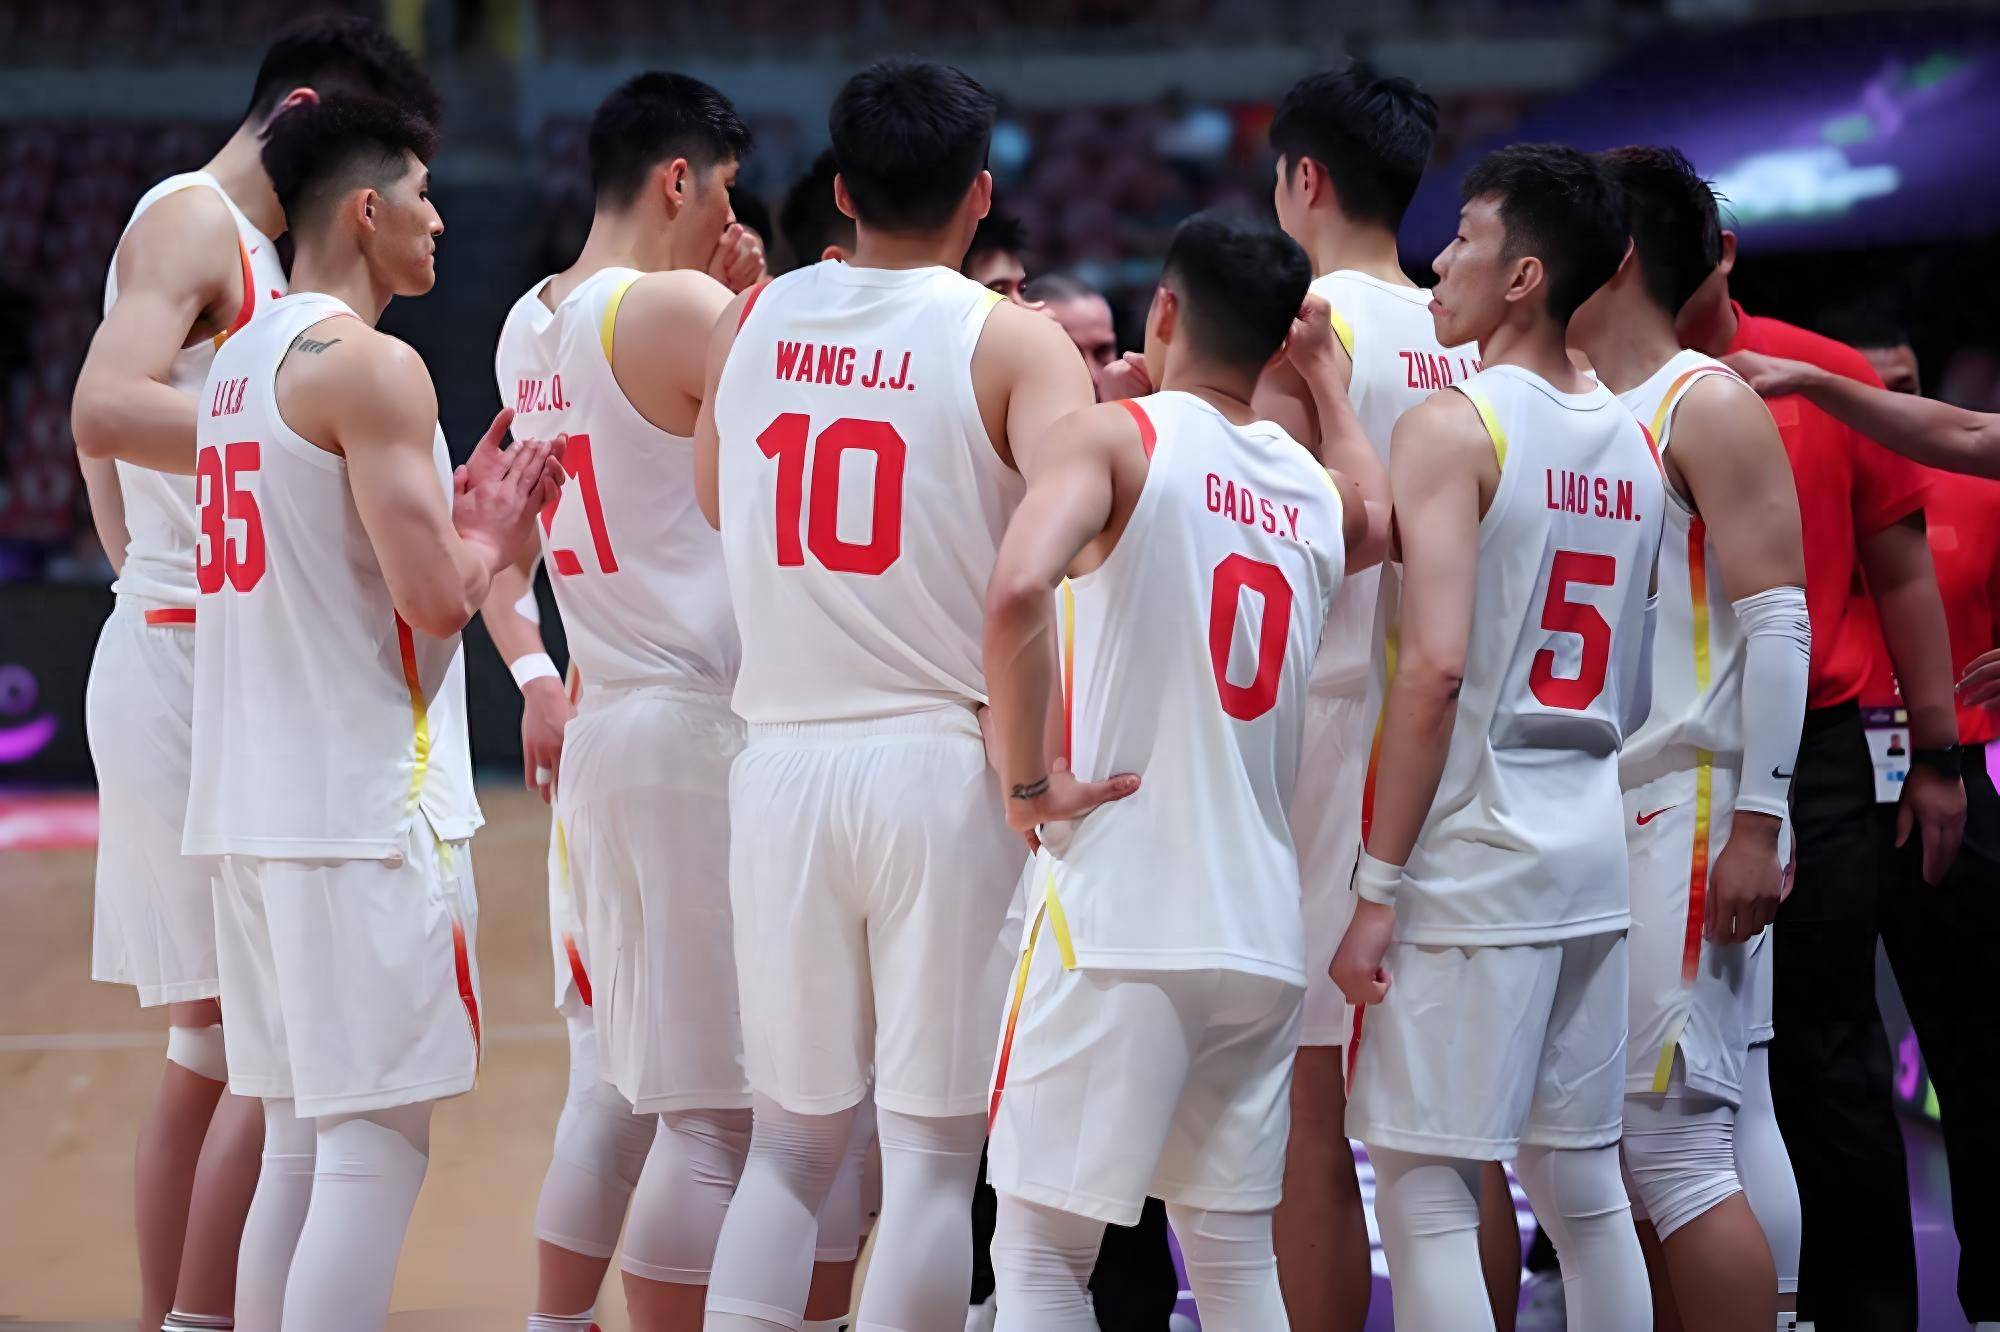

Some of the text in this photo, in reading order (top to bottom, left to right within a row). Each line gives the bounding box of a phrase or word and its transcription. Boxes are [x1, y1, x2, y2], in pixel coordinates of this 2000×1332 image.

[776, 341, 915, 391] WANG J.J.
[196, 442, 266, 594] 35
[756, 413, 906, 576] 10
[1547, 469, 1641, 522] LIAO S.N.
[1209, 553, 1293, 721] 0
[1529, 550, 1616, 711] 5
